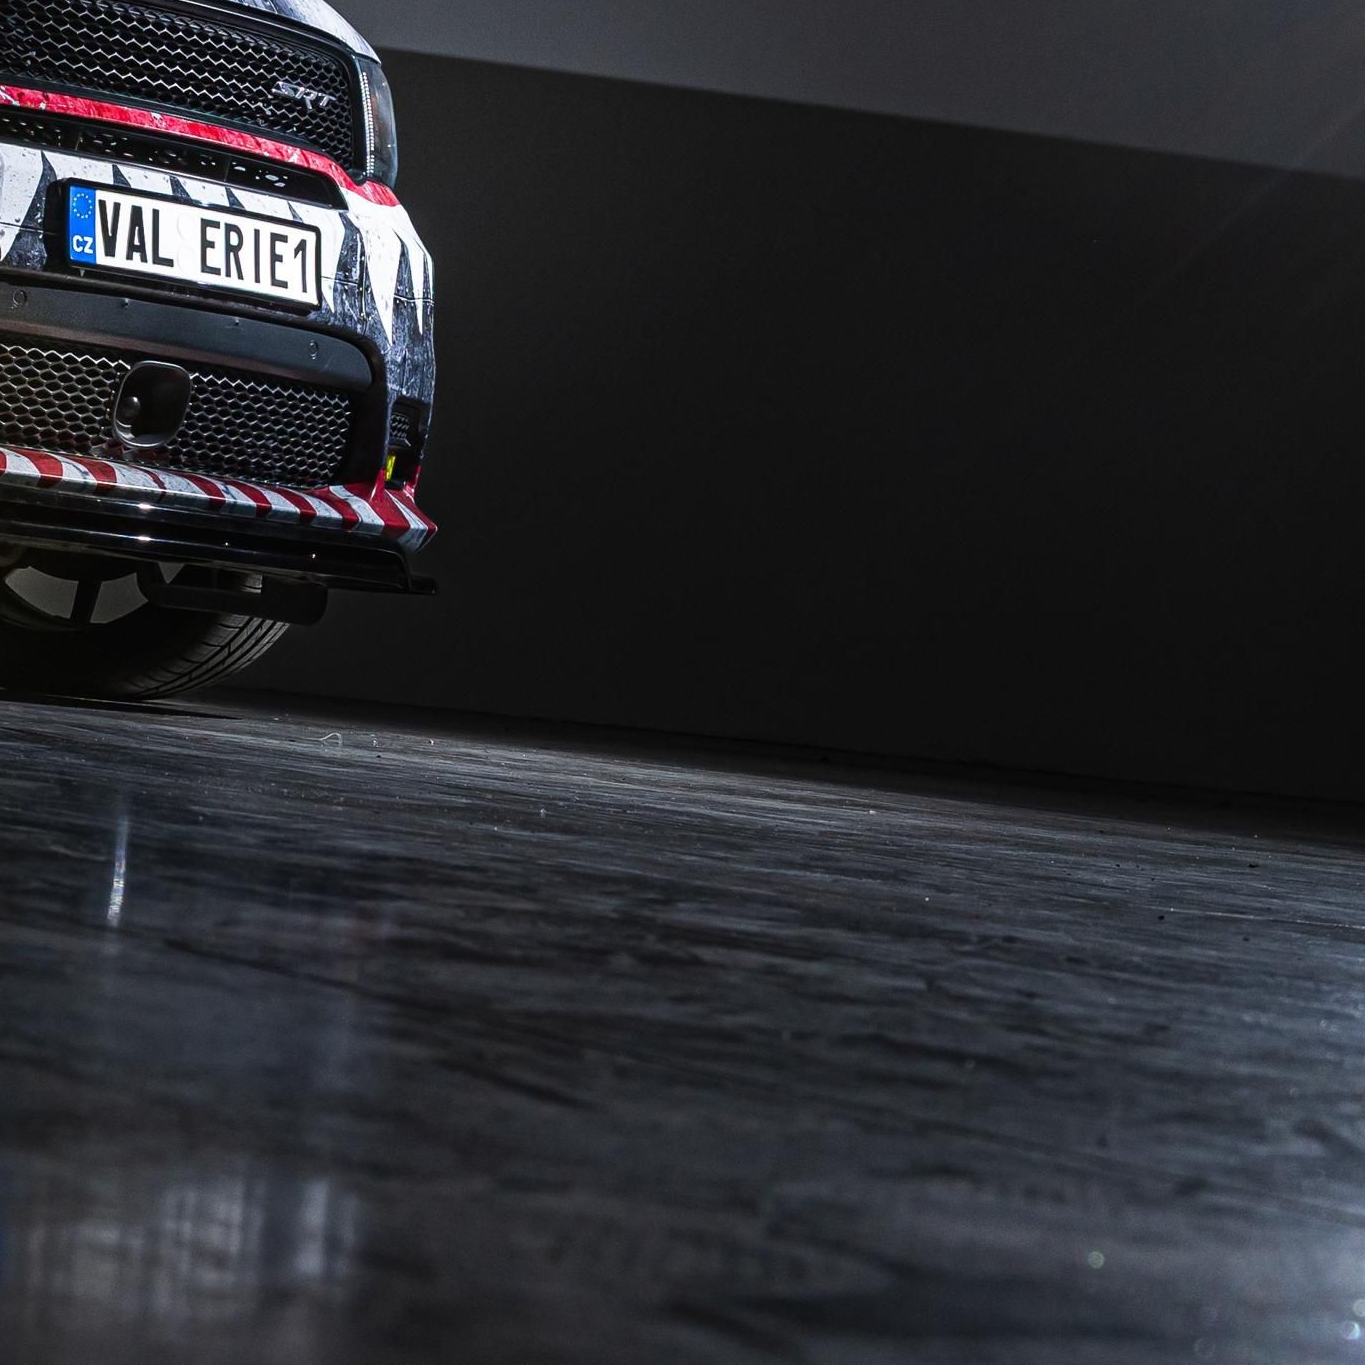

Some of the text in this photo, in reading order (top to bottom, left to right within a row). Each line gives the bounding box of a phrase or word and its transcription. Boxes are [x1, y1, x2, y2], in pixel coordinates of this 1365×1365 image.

[271, 80, 337, 110] SRT
[72, 233, 95, 255] CZ
[98, 198, 309, 294] VAL ERIE1
